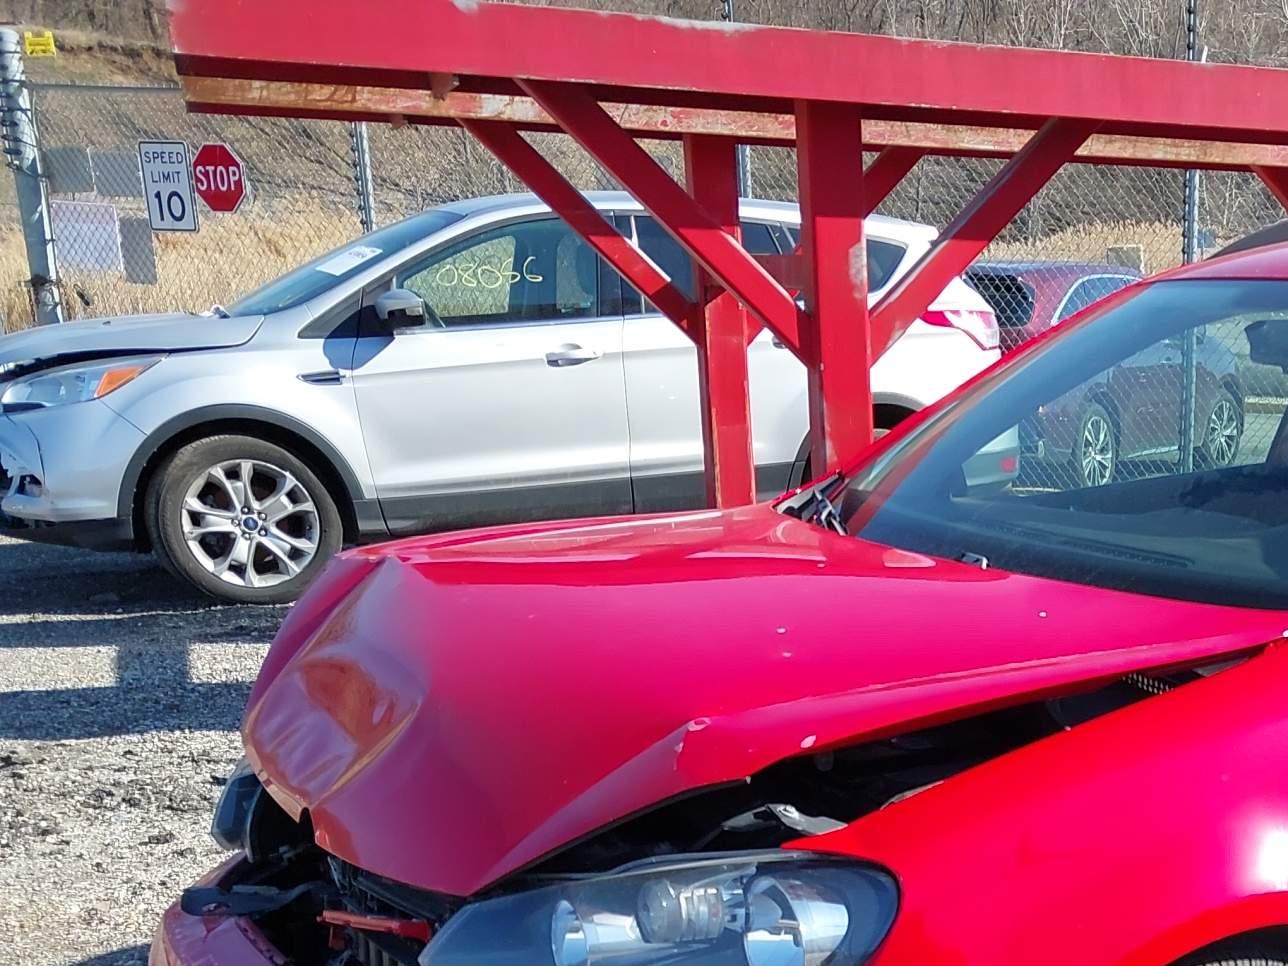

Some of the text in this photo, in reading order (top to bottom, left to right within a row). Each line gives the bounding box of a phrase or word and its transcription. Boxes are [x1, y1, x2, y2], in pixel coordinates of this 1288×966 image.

[143, 151, 184, 165] SPEED
[150, 170, 182, 184] LIMIT
[195, 165, 240, 192] STOP
[154, 190, 186, 222] 10
